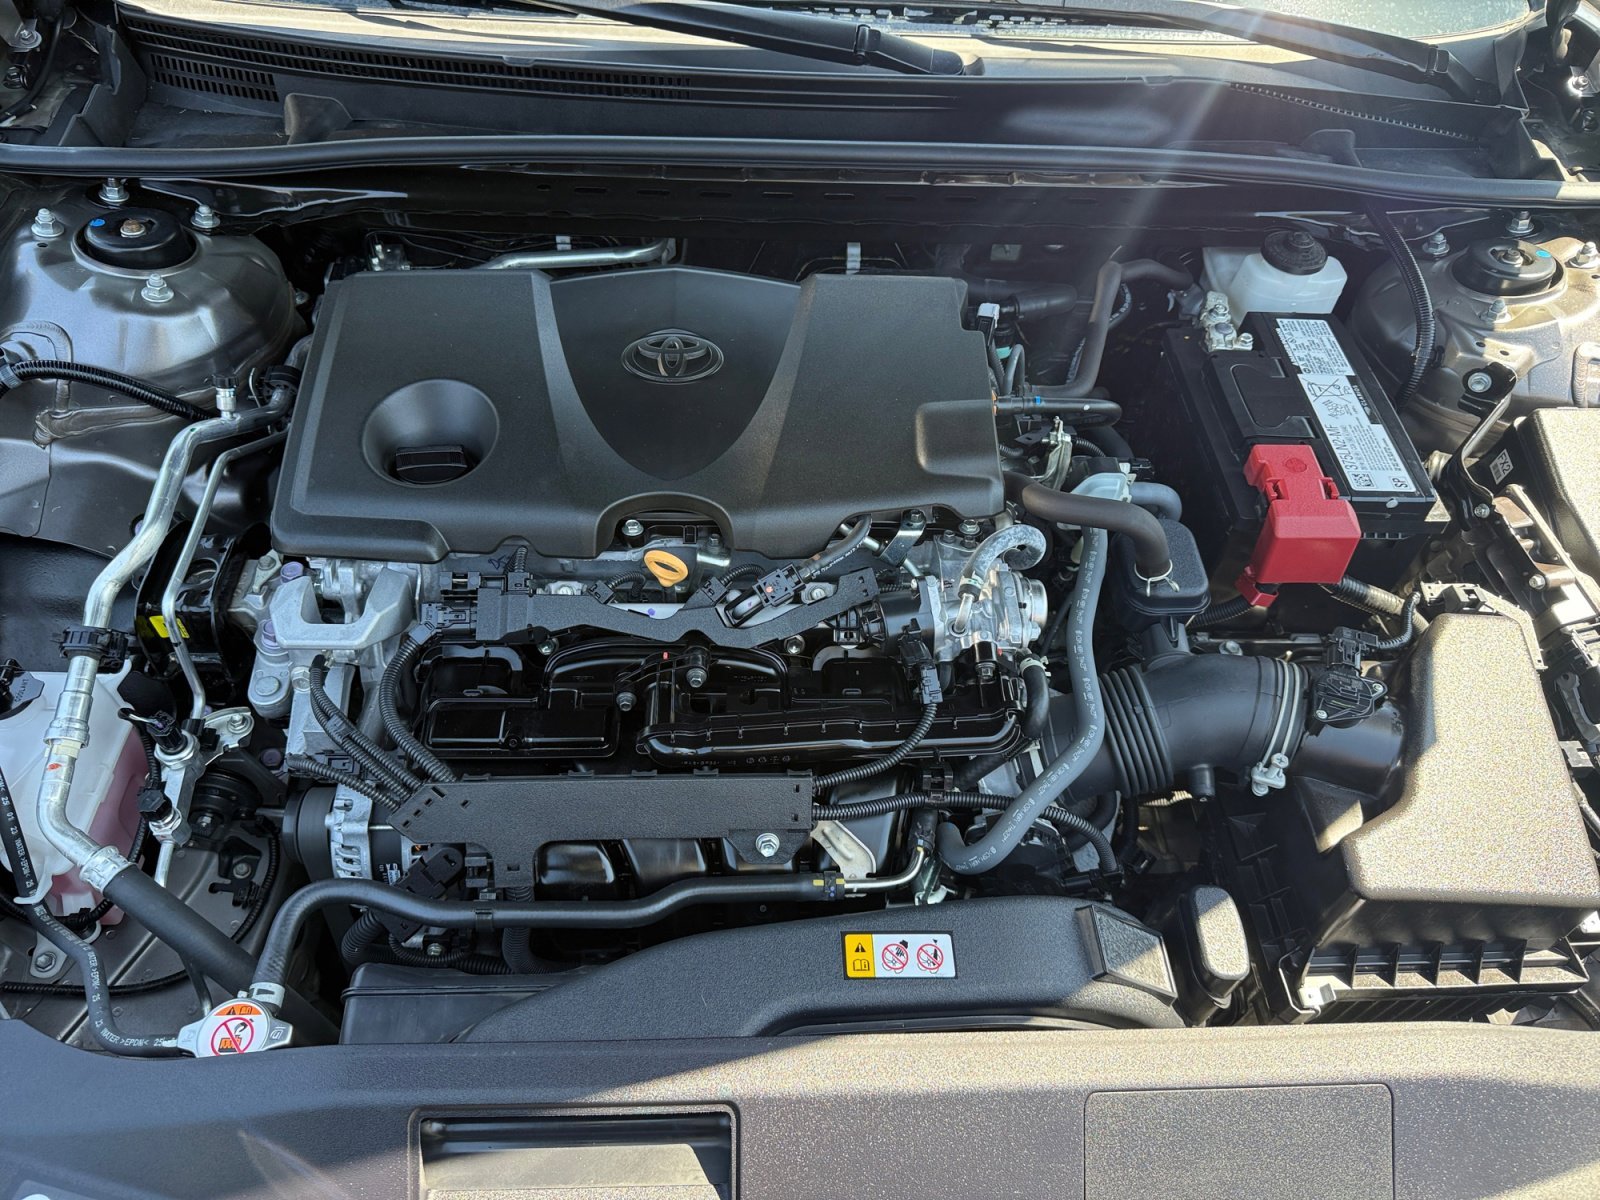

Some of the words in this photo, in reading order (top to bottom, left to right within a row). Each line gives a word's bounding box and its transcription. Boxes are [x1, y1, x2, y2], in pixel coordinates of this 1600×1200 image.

[1343, 386, 1353, 395] Pb
[1352, 385, 1368, 407] CLARIOS
[1325, 425, 1358, 470] 375LN2-MF
[1498, 452, 1511, 475] FX2
[1394, 478, 1408, 488] SP
[1, 796, 10, 806] 25
[15, 838, 26, 857] WATER
[101, 1028, 120, 1044] WATER
